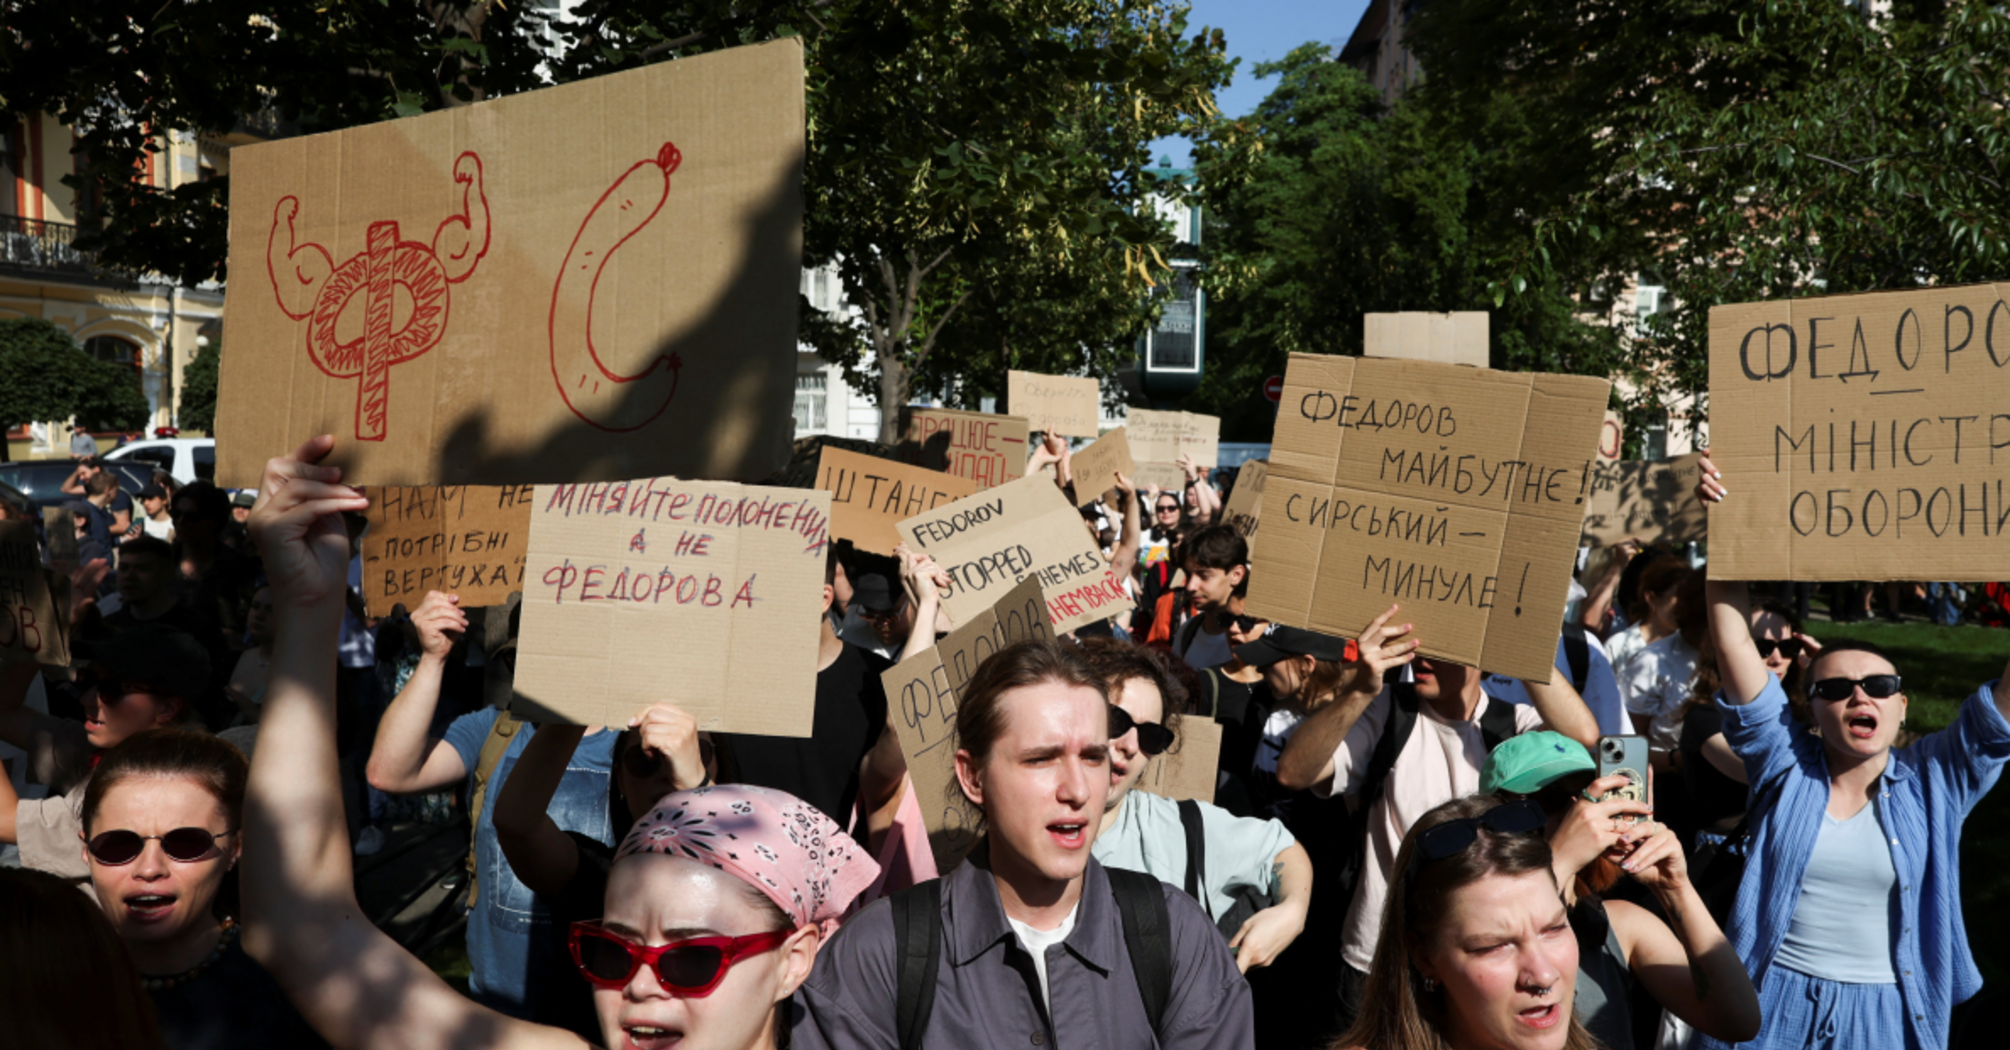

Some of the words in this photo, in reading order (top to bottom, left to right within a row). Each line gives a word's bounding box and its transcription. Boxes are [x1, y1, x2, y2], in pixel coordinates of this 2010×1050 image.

[1300, 390, 1456, 437] ФЕДОРОВ
[382, 486, 467, 522] НАМ
[498, 484, 534, 509] НЕ
[911, 498, 1003, 548] FEDOROV
[1286, 493, 1449, 546] СИРСЬКИЙ
[674, 530, 714, 557] НЕ
[542, 558, 764, 609] ФЕДОРОВА
[1015, 551, 1100, 590] SHEMES
